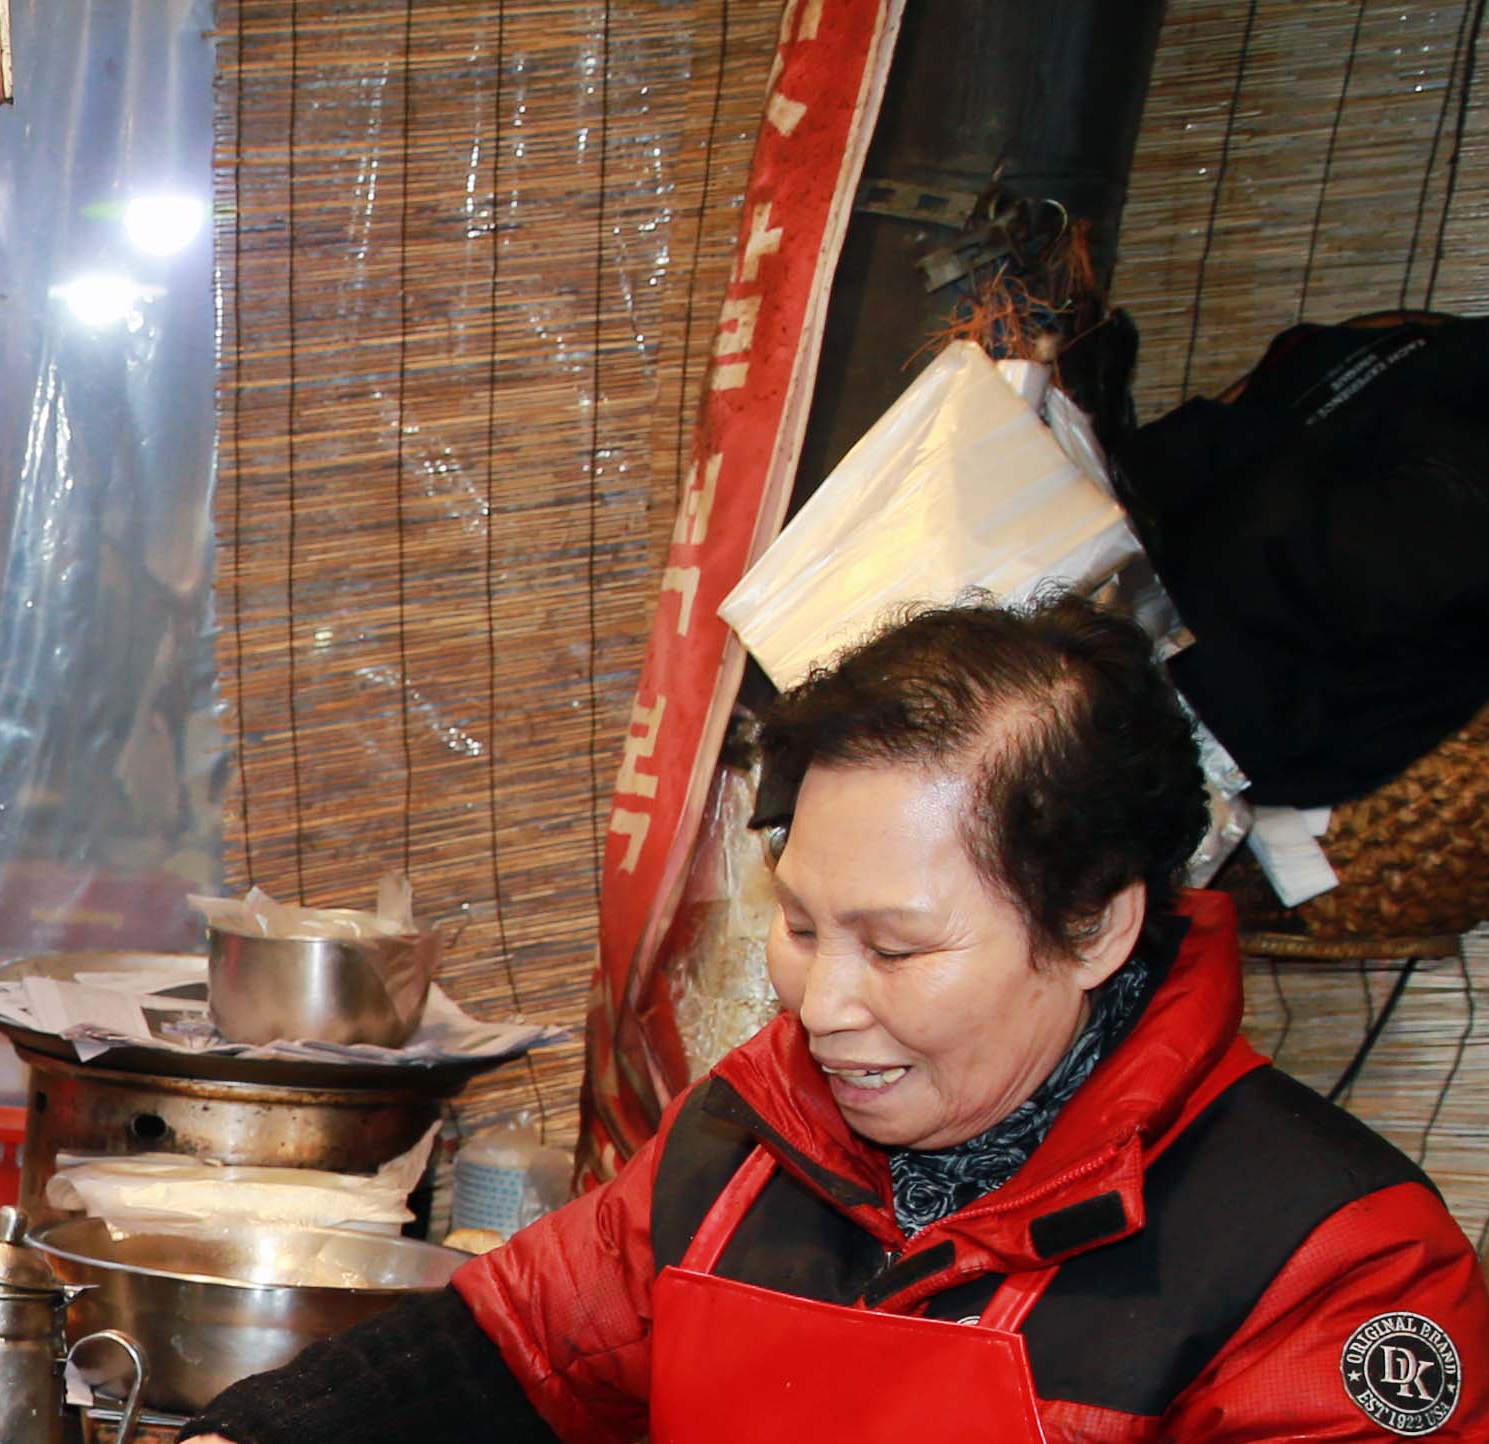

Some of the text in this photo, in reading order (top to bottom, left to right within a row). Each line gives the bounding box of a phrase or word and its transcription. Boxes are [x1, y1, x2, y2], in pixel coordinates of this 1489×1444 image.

[1346, 1316, 1457, 1376] ORIGINAL BRAND
[1356, 1389, 1451, 1430] EST 1922 USA
